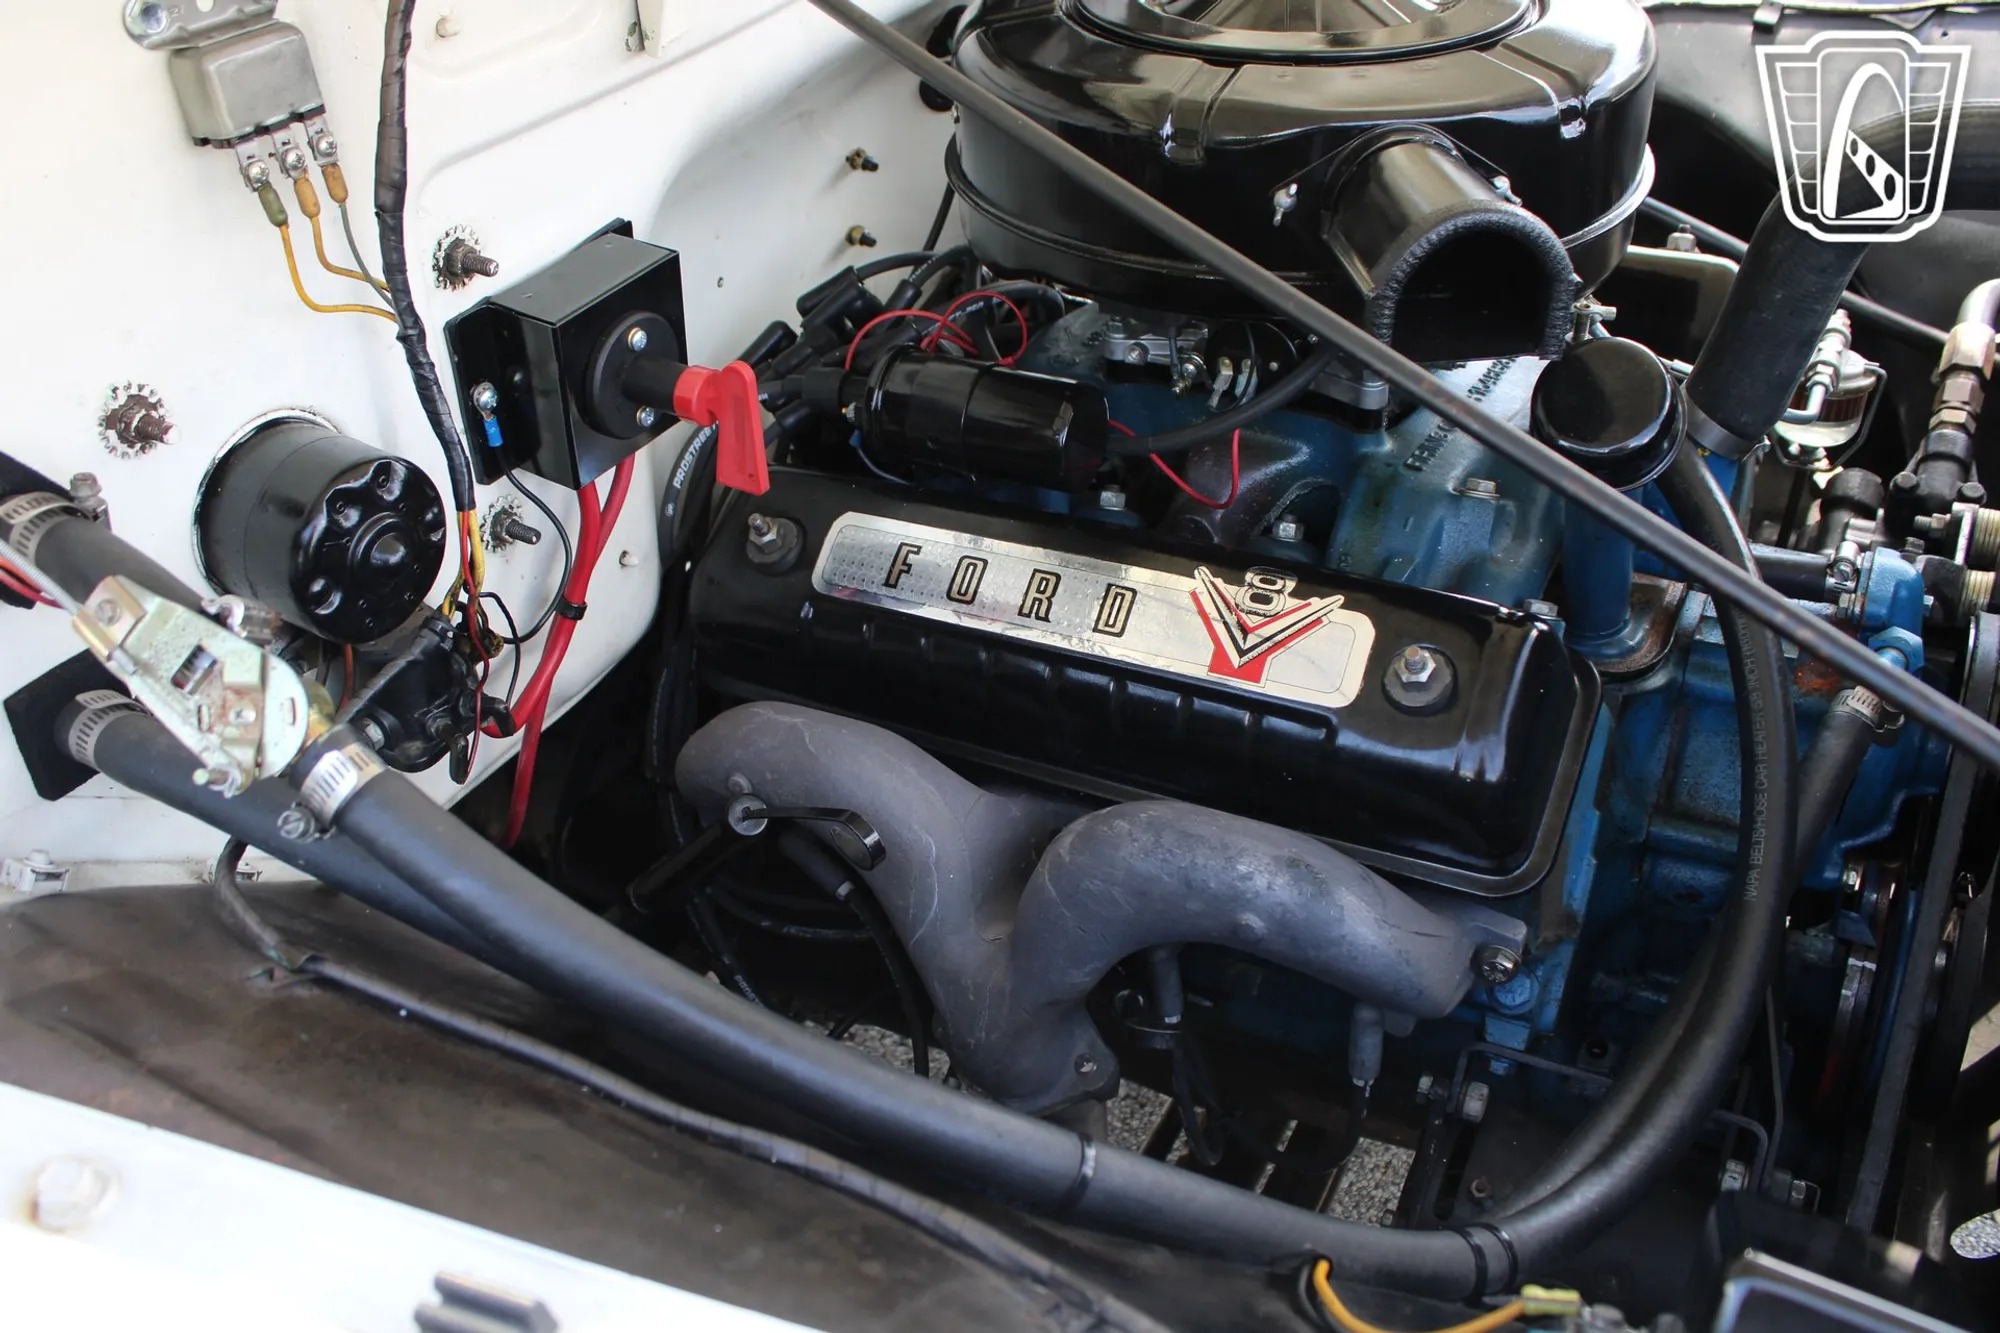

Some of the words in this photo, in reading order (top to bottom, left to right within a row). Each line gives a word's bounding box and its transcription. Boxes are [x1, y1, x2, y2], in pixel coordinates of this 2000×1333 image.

[883, 541, 1138, 638] FORD
[1753, 713, 1767, 760] HEATER
[1755, 764, 1768, 789] CAR
[1744, 868, 1760, 901] NAPA
